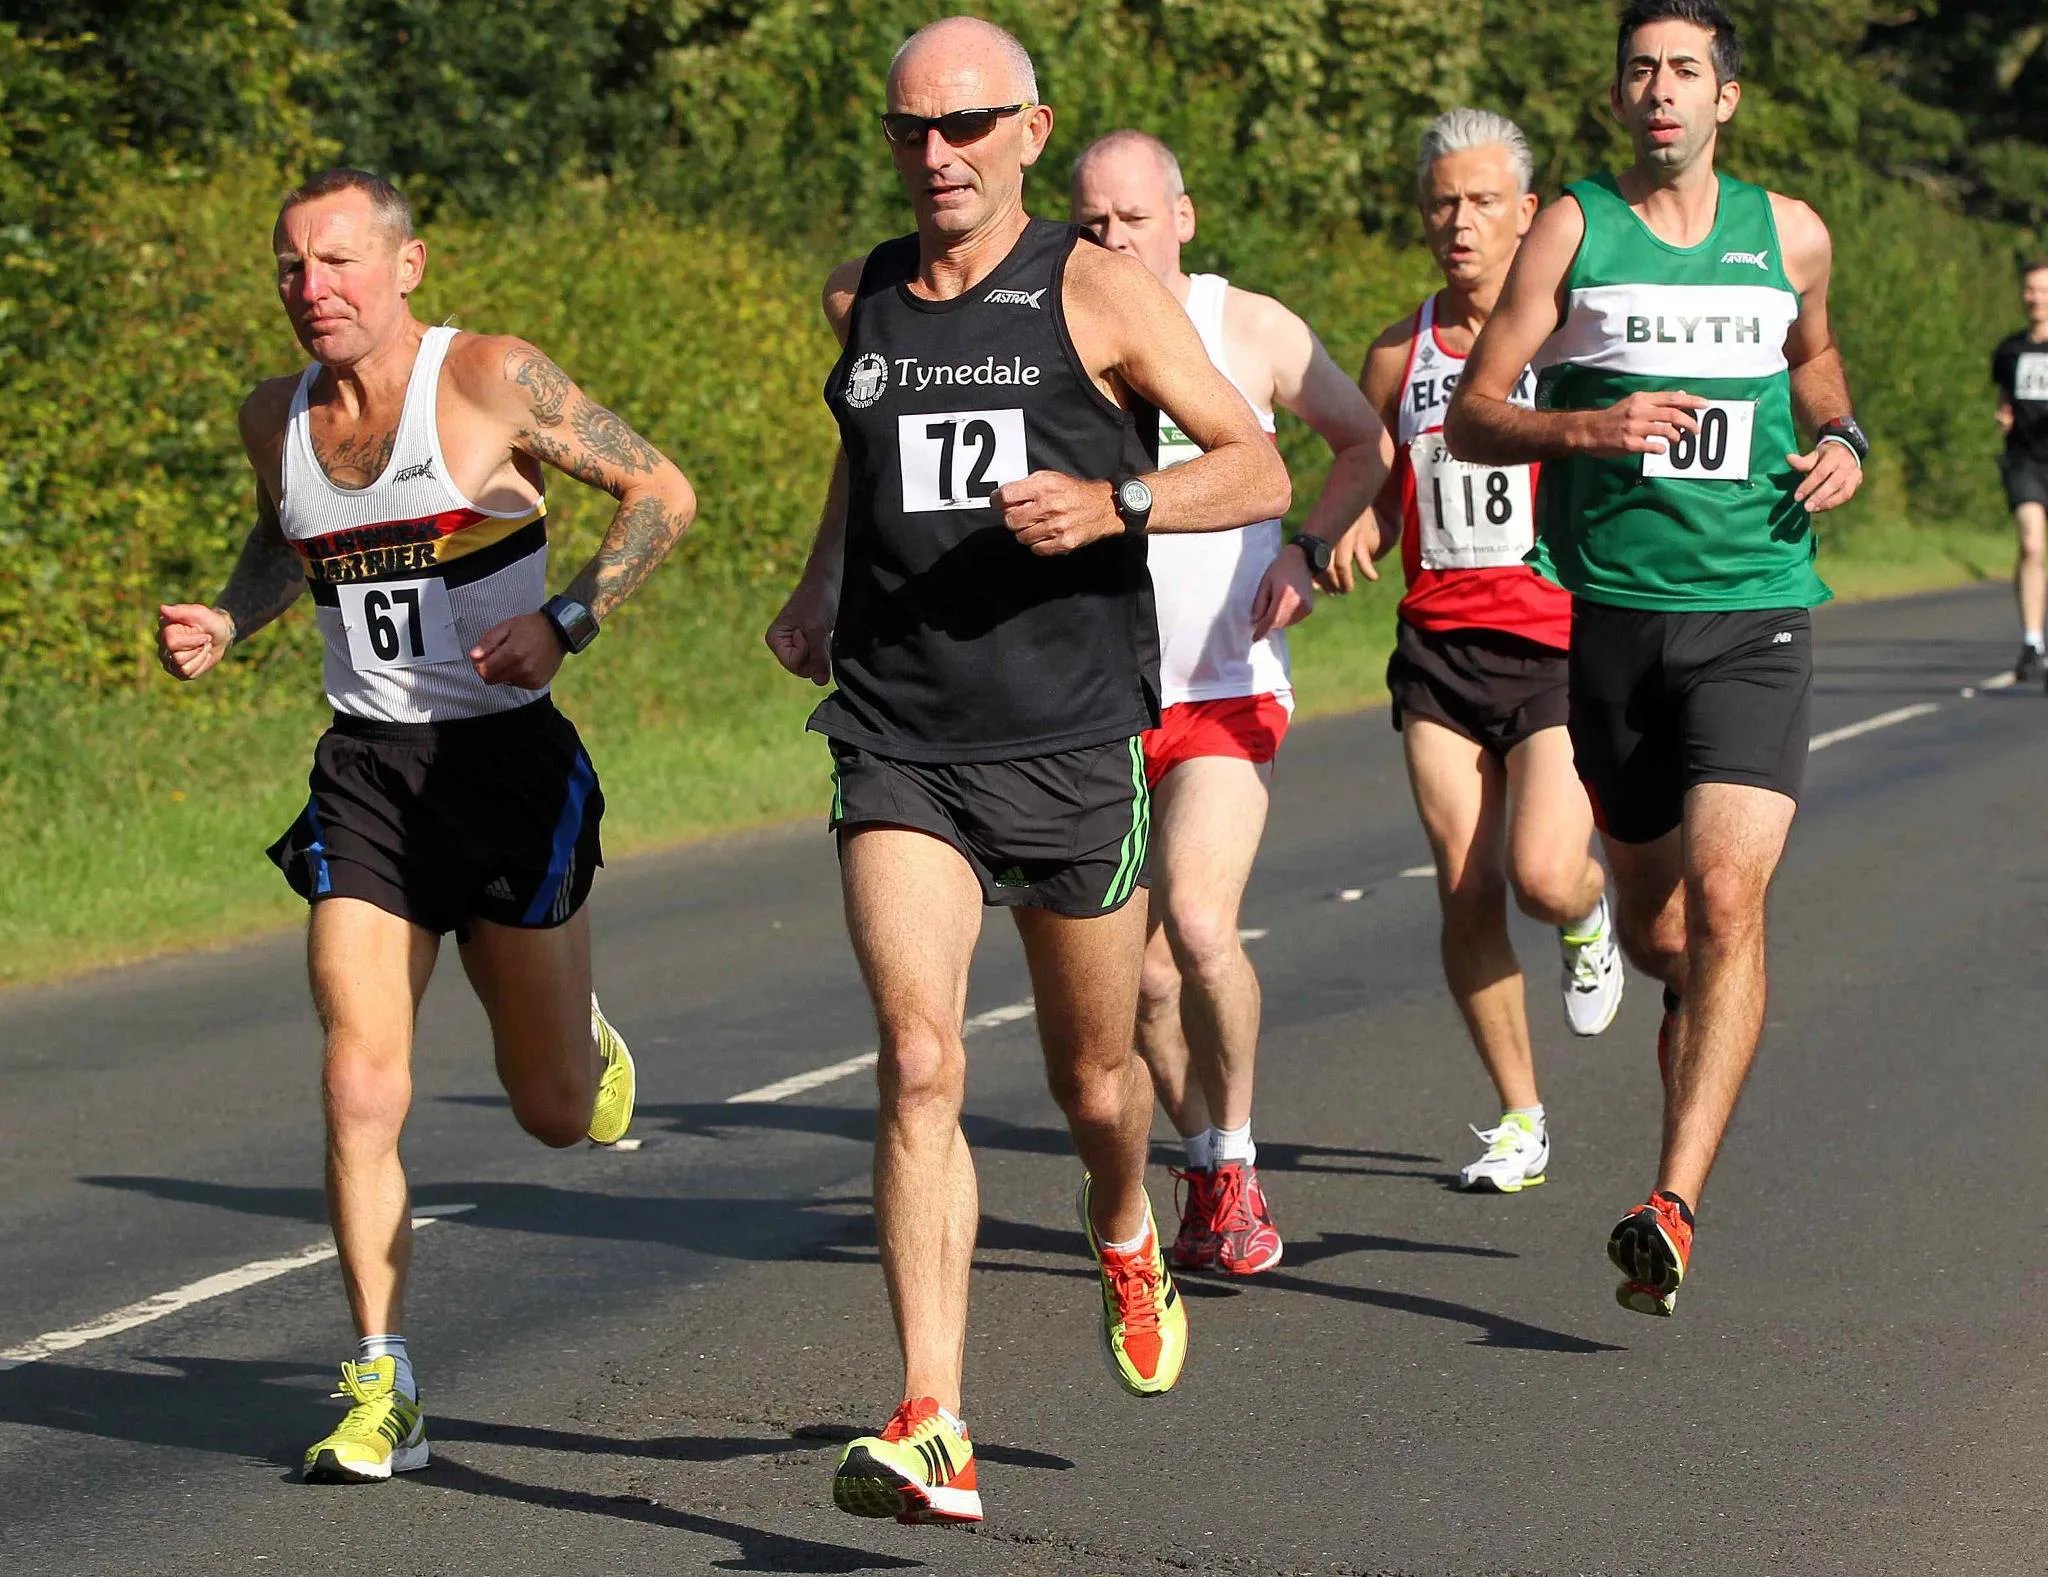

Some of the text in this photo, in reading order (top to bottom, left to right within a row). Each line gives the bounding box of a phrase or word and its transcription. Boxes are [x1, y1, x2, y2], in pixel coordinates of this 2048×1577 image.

[983, 287, 1047, 310] FASTRAX
[1626, 316, 1761, 344] BLYTH
[894, 356, 1041, 392] Tynedale
[1412, 370, 1530, 413] ELSK
[925, 419, 999, 501] 72
[1669, 407, 1728, 471] 60
[1432, 471, 1513, 530] 118
[363, 588, 426, 662] 67
